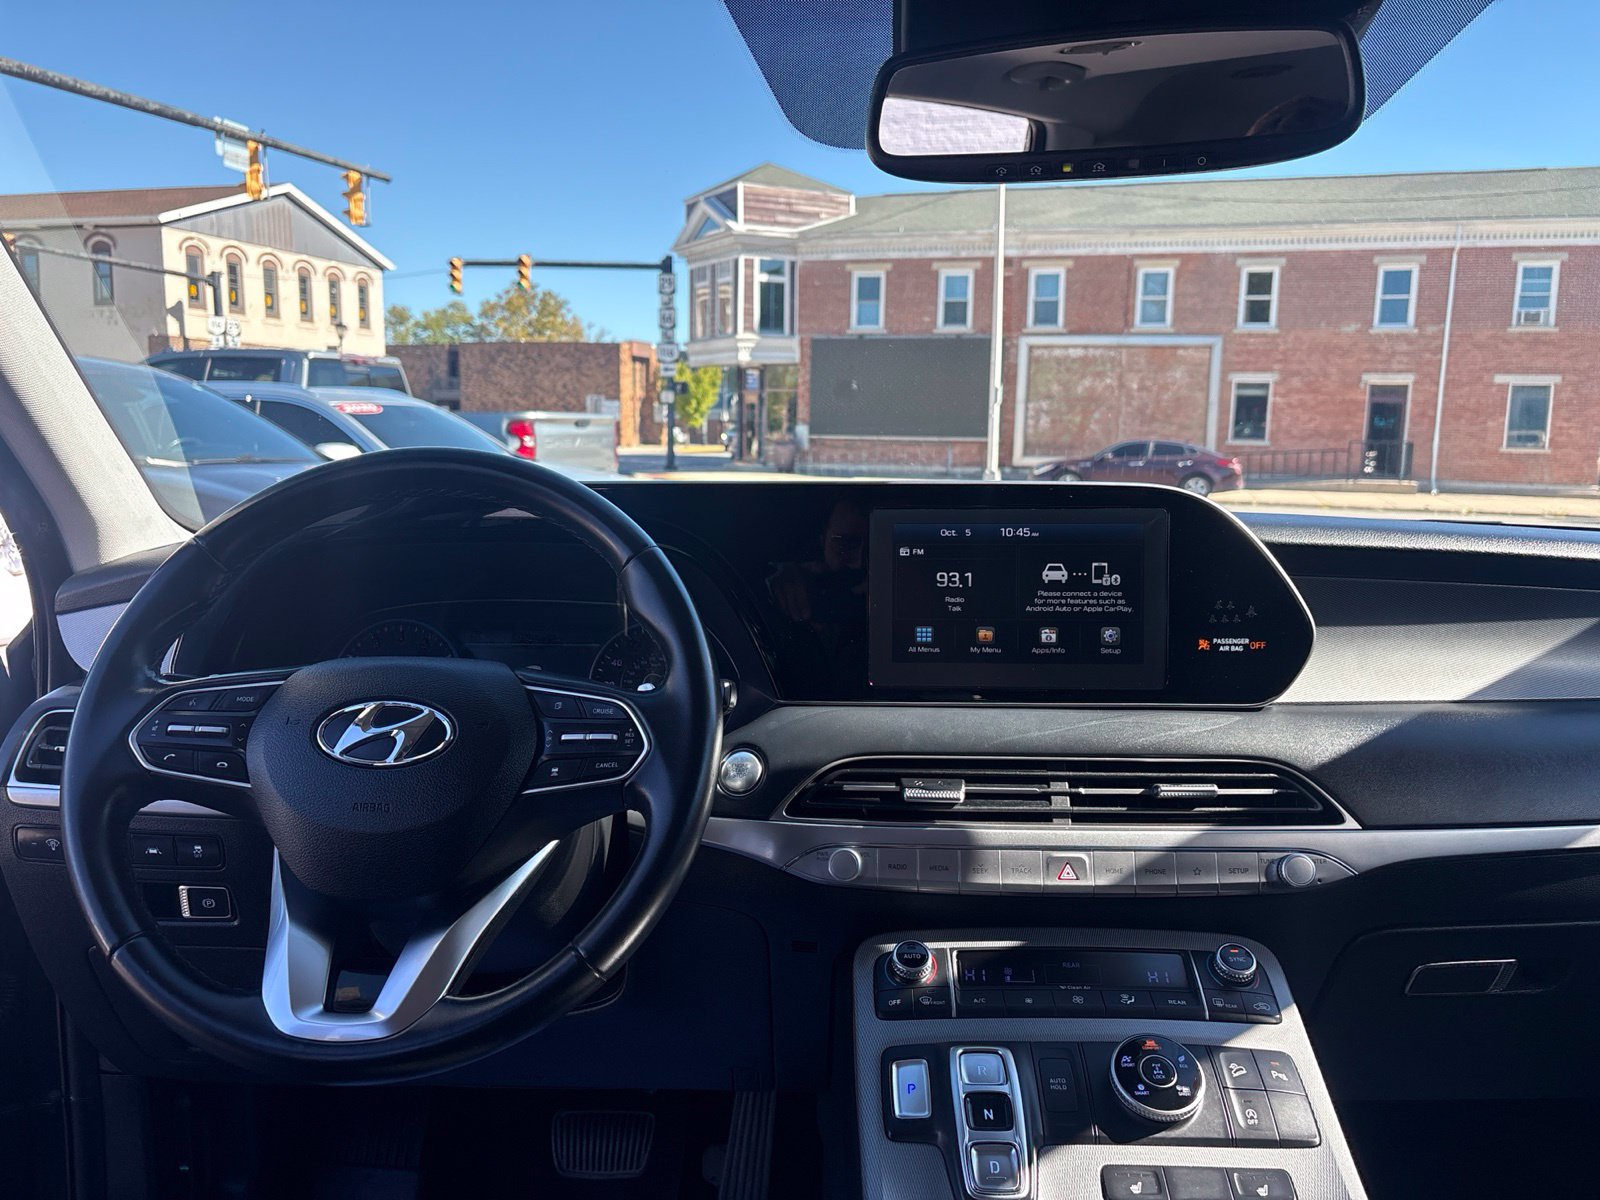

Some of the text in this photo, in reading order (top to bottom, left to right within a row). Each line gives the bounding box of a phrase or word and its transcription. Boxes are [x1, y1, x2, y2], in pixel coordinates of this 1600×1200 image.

[965, 529, 972, 537] 5
[1000, 528, 1031, 537] 10:45
[936, 572, 973, 587] 93.1
[1082, 605, 1103, 613] Apple
[1249, 641, 1267, 650] OFF
[970, 646, 981, 654] My
[1031, 647, 1066, 655] Apps/Info
[1100, 647, 1122, 655] Setup
[236, 695, 255, 703] MODE
[592, 707, 614, 715] CRUISE
[595, 761, 619, 769] CANCEL
[351, 801, 391, 814] AIRBAG
[887, 863, 908, 871] RADIO
[972, 867, 989, 875] SEEK
[1010, 867, 1033, 875] TRACK
[1105, 867, 1124, 875] HOME
[1228, 867, 1250, 875] SETUP
[1228, 955, 1247, 963] SYNC
[888, 999, 902, 1007] OFF
[977, 1065, 987, 1075] R
[907, 1083, 916, 1095] P
[984, 1108, 994, 1120] N
[1247, 1119, 1259, 1127] OFF
[989, 1160, 1000, 1174] D
